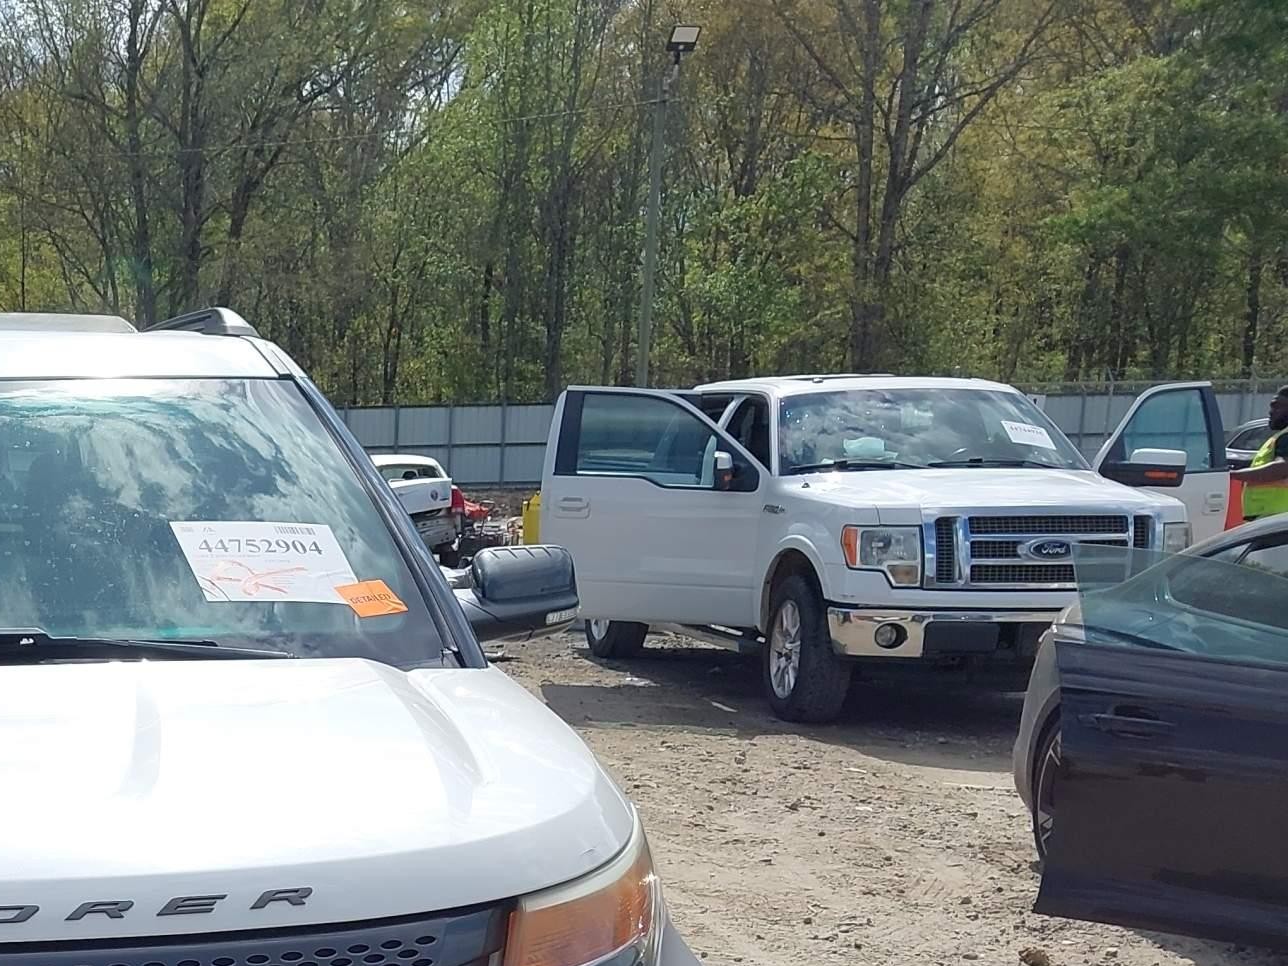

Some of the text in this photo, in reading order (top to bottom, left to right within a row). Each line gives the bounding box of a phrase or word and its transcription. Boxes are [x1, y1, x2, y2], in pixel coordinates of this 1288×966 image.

[198, 538, 323, 556] 44752904
[1041, 543, 1066, 554] Ford
[350, 592, 392, 604] DETAILED
